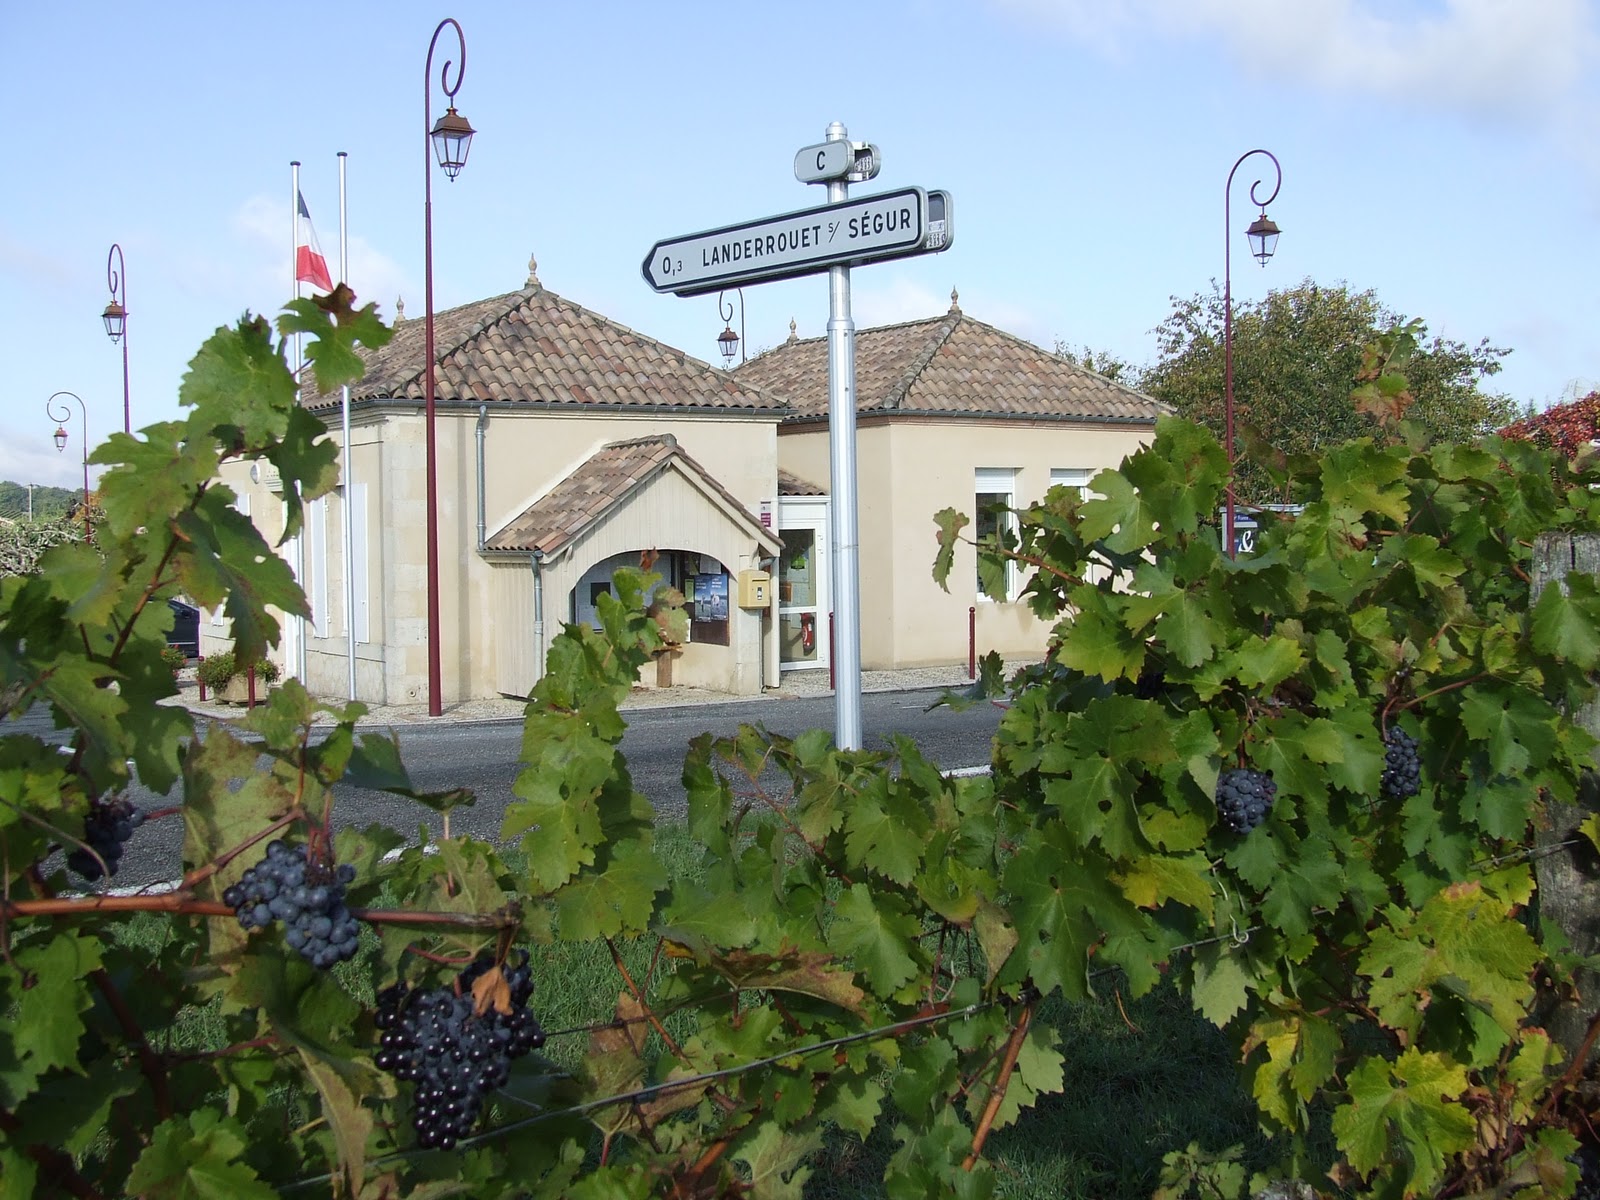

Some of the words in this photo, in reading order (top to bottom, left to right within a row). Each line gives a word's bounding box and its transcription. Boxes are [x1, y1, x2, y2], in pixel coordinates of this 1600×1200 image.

[816, 151, 826, 171] C
[662, 256, 683, 276] 0,3
[702, 225, 821, 267] LANDERROUET
[848, 208, 911, 239] SÉGUR
